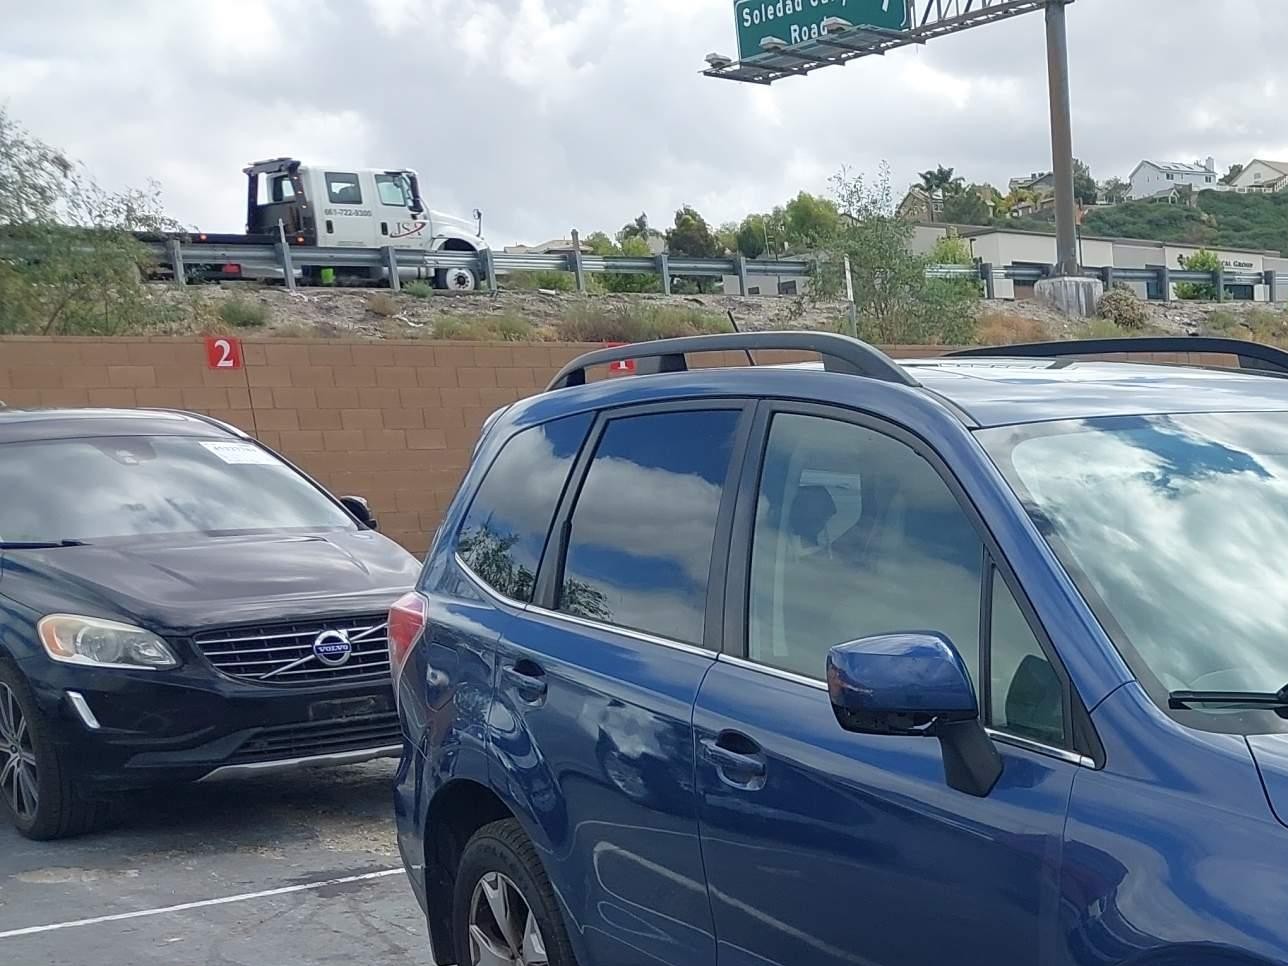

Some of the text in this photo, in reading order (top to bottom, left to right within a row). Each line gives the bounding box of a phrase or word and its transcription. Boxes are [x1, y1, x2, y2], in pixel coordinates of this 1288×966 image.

[743, 0, 802, 27] Soledad
[790, 16, 828, 44] Road
[214, 339, 234, 367] 2
[318, 644, 349, 652] VOLVO
